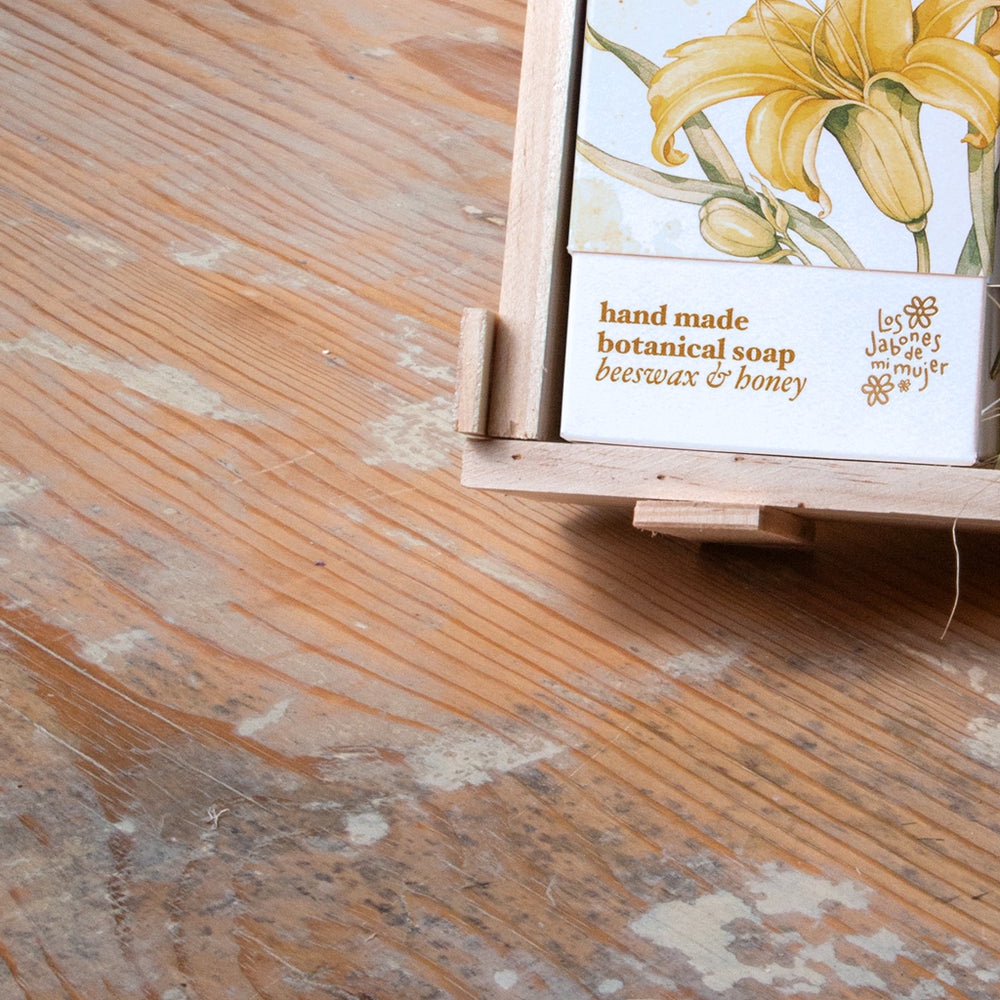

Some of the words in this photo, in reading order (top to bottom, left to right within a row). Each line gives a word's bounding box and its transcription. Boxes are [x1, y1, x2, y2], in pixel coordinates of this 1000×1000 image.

[599, 300, 668, 326] hand
[673, 308, 749, 331] made
[878, 308, 903, 334] Los
[597, 331, 726, 360] botanical
[732, 345, 796, 371] soap
[865, 331, 941, 357] Jabones
[904, 346, 923, 361] de
[595, 357, 700, 387] beeswax
[706, 361, 732, 388] &
[734, 365, 807, 401] honey
[871, 358, 890, 369] mi
[894, 359, 949, 392] mujer
